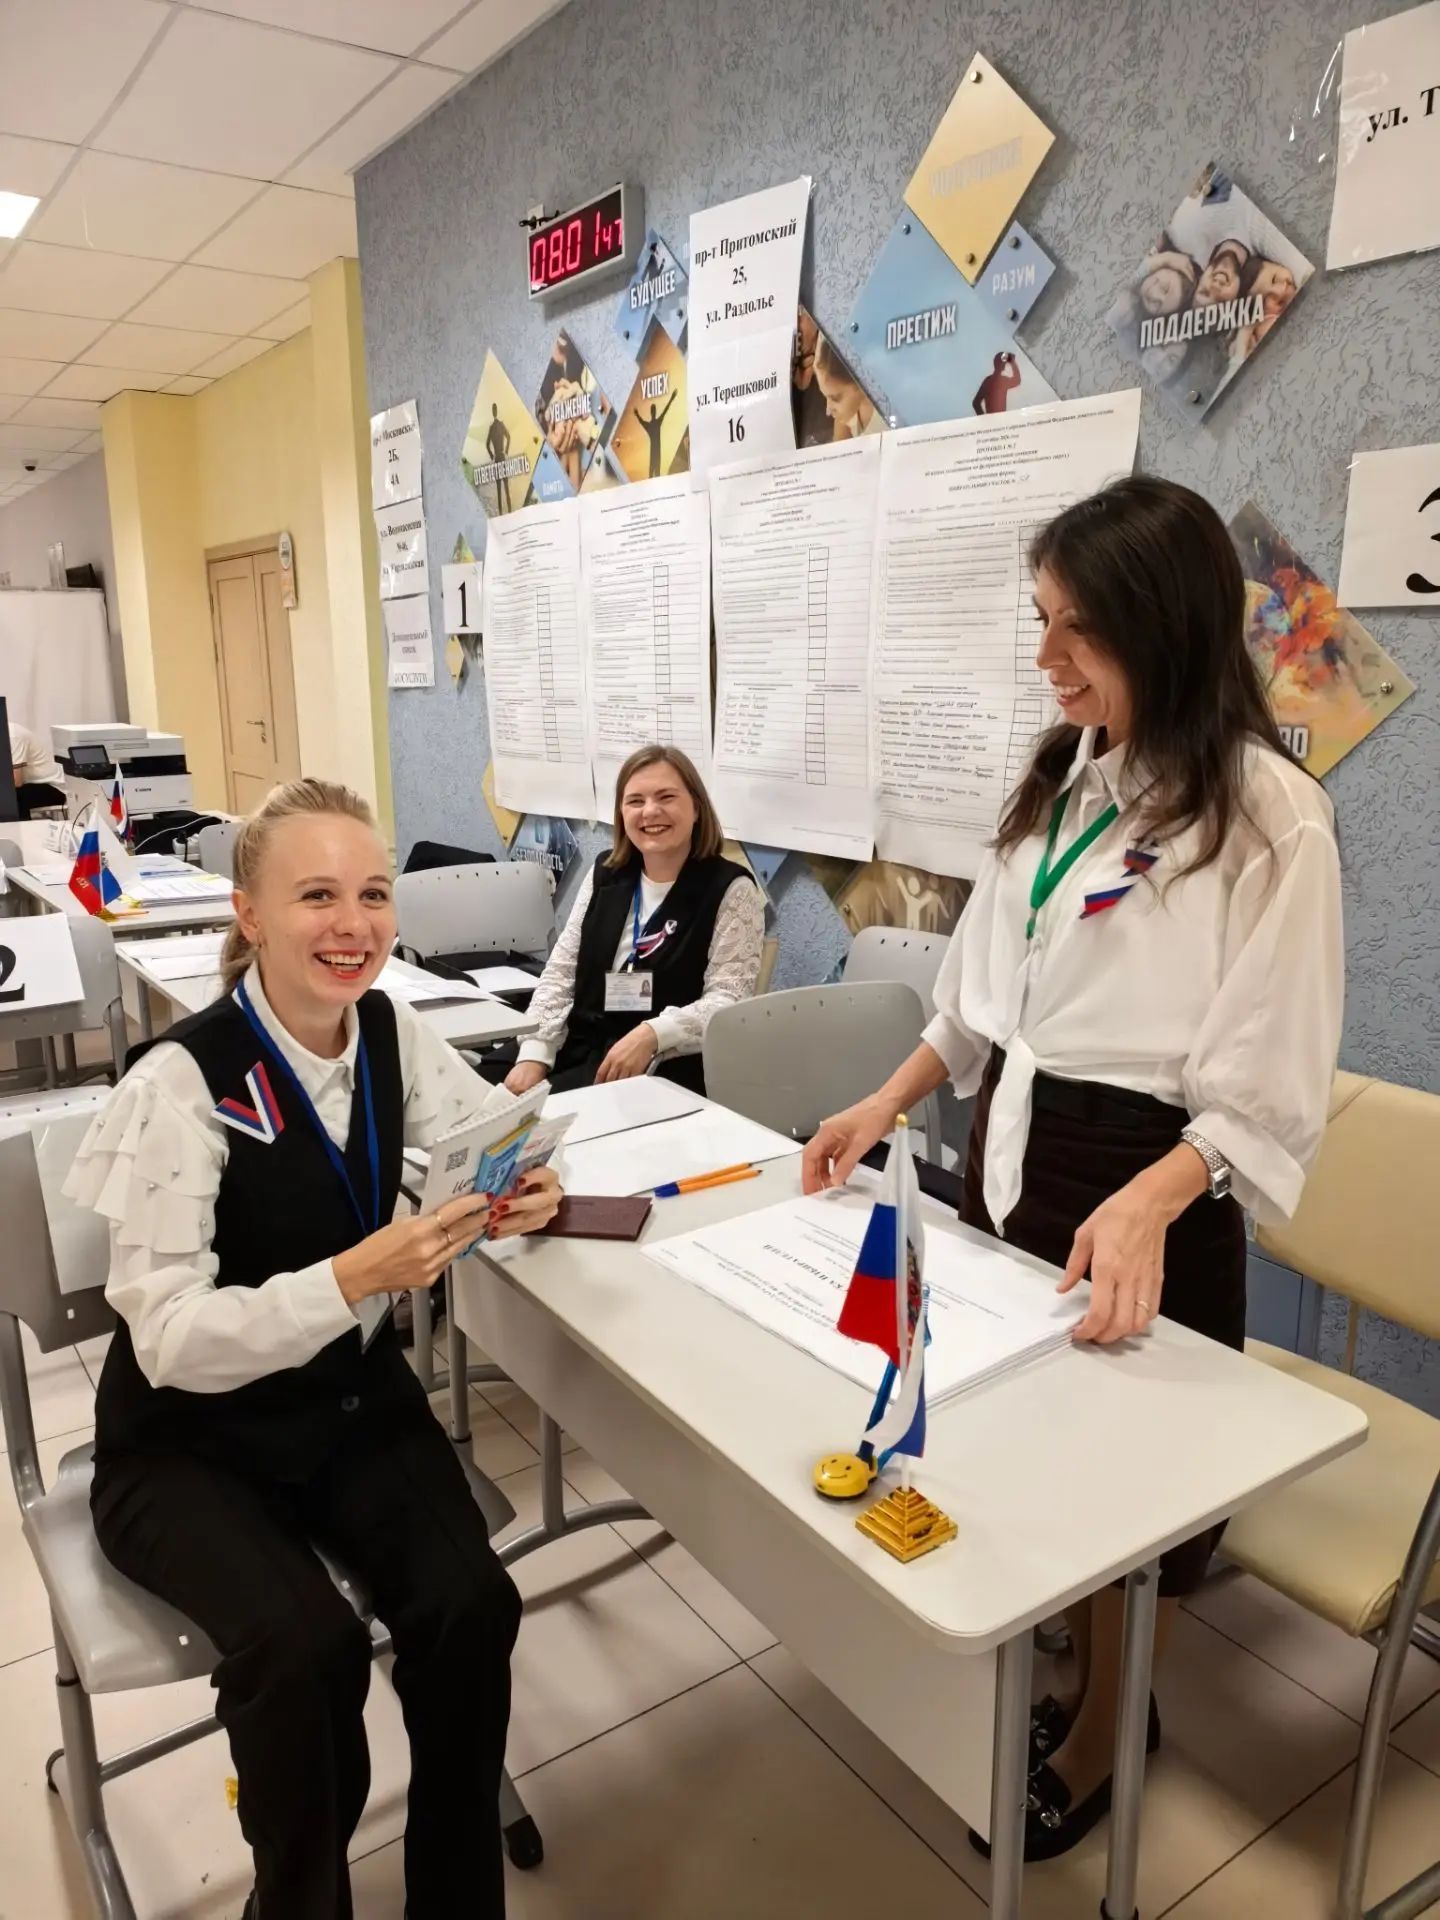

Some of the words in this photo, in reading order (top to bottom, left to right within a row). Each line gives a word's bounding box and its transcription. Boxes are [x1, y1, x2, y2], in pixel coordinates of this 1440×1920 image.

[1366, 106, 1408, 143] ул.
[695, 246, 718, 267] пр-т
[719, 218, 797, 258] Притомский
[630, 269, 676, 310] БУДУЩЕЕ
[992, 263, 1036, 297] РАЗУМ
[706, 310, 721, 329] ул.
[724, 294, 775, 320] Раздолье
[887, 304, 957, 350] ПРЕСТИЖ
[1140, 293, 1265, 349] ПОДДЕРЖКА
[641, 371, 669, 400] УСПЕХ
[696, 393, 711, 412] ул.
[712, 371, 778, 404] Терешковой
[550, 392, 592, 423] УВАЖЕНИЕ
[728, 414, 745, 443] 16
[457, 581, 470, 628] 1
